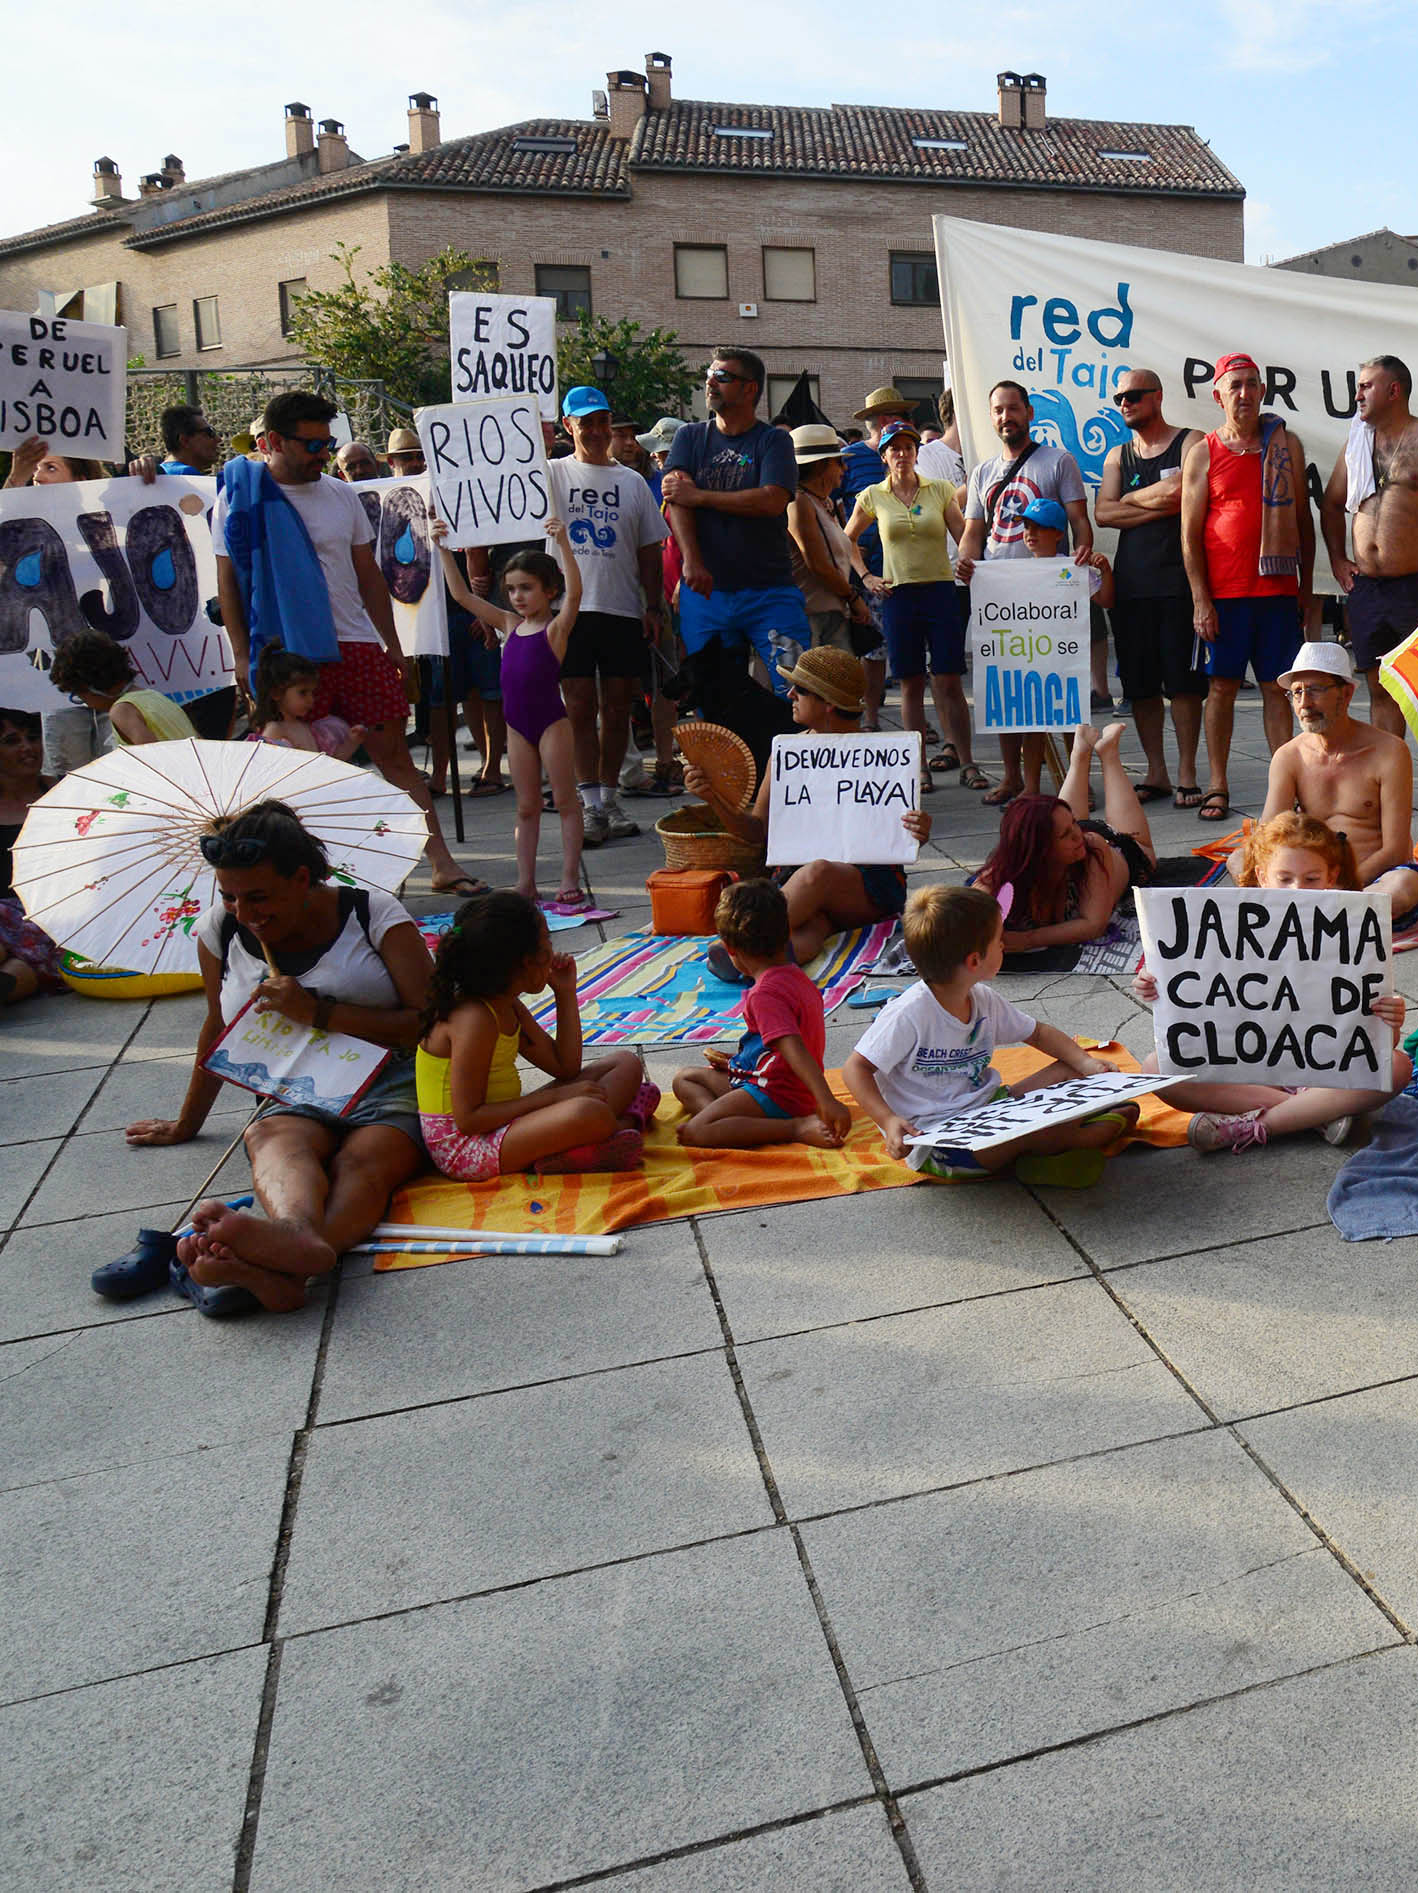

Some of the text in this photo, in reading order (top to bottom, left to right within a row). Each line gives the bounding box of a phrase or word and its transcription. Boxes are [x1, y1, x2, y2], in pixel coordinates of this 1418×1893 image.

[30, 317, 67, 341] DE
[473, 306, 531, 350] ES
[1009, 283, 1135, 348] red
[0, 343, 111, 374] ERUEL
[457, 348, 556, 394] SAQUEO
[1012, 347, 1043, 372] del
[29, 379, 53, 399] A
[1183, 357, 1300, 412] PR
[430, 408, 535, 474] RIOS
[437, 470, 548, 534] VIVOS
[568, 484, 620, 508] red
[568, 504, 620, 524] del Tajo
[978, 600, 1078, 626] ¡Colabora!
[980, 629, 1079, 663] el Tajo se
[776, 745, 911, 781] ¡DEVOLVEDNOS
[784, 784, 812, 806] LA
[1158, 896, 1387, 965] JARAMA
[1167, 970, 1385, 1016] CACA DE
[916, 1047, 947, 1059] BEACH
[1166, 1020, 1379, 1073] CLOACA
